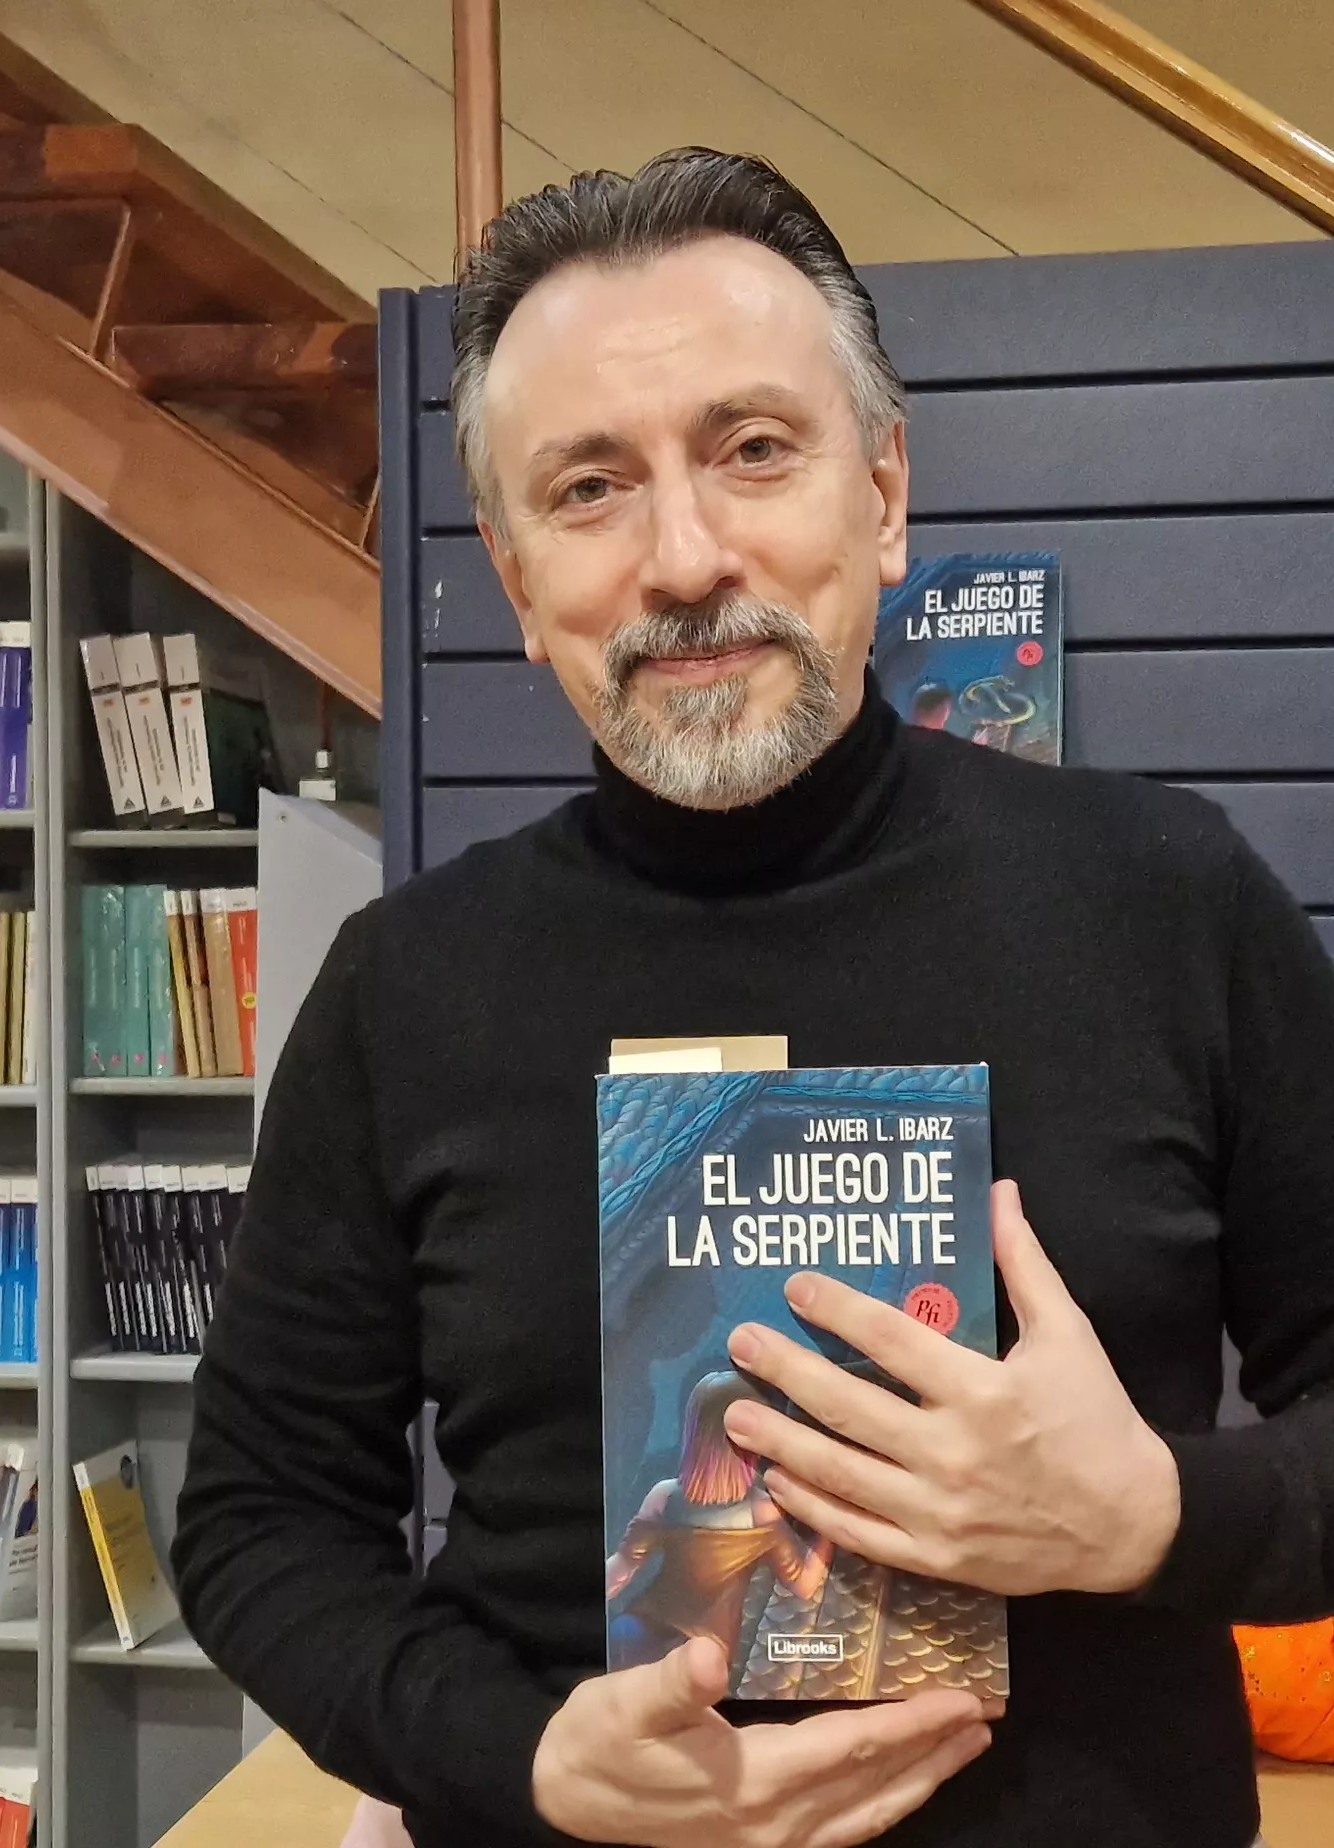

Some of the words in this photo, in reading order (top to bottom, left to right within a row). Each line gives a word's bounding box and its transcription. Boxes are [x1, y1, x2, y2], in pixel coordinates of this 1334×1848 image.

[974, 572, 1005, 584] JAVIER
[1008, 572, 1017, 583] L.
[1019, 570, 1045, 582] IBARZ
[925, 589, 948, 614] EL
[951, 585, 1014, 611] JUEGO
[1019, 584, 1044, 608] DE
[906, 616, 932, 641] LA
[937, 610, 1043, 638] SERPIENTE
[804, 1118, 869, 1143] JAVIER
[876, 1118, 894, 1142] L.
[899, 1117, 954, 1142] IBARZ
[702, 1154, 751, 1206] EL
[759, 1152, 889, 1205] JUEGO
[903, 1151, 954, 1203] DE
[667, 1215, 720, 1268] LA
[733, 1212, 957, 1267] SERPIENTE
[773, 1640, 838, 1657] Librooks
